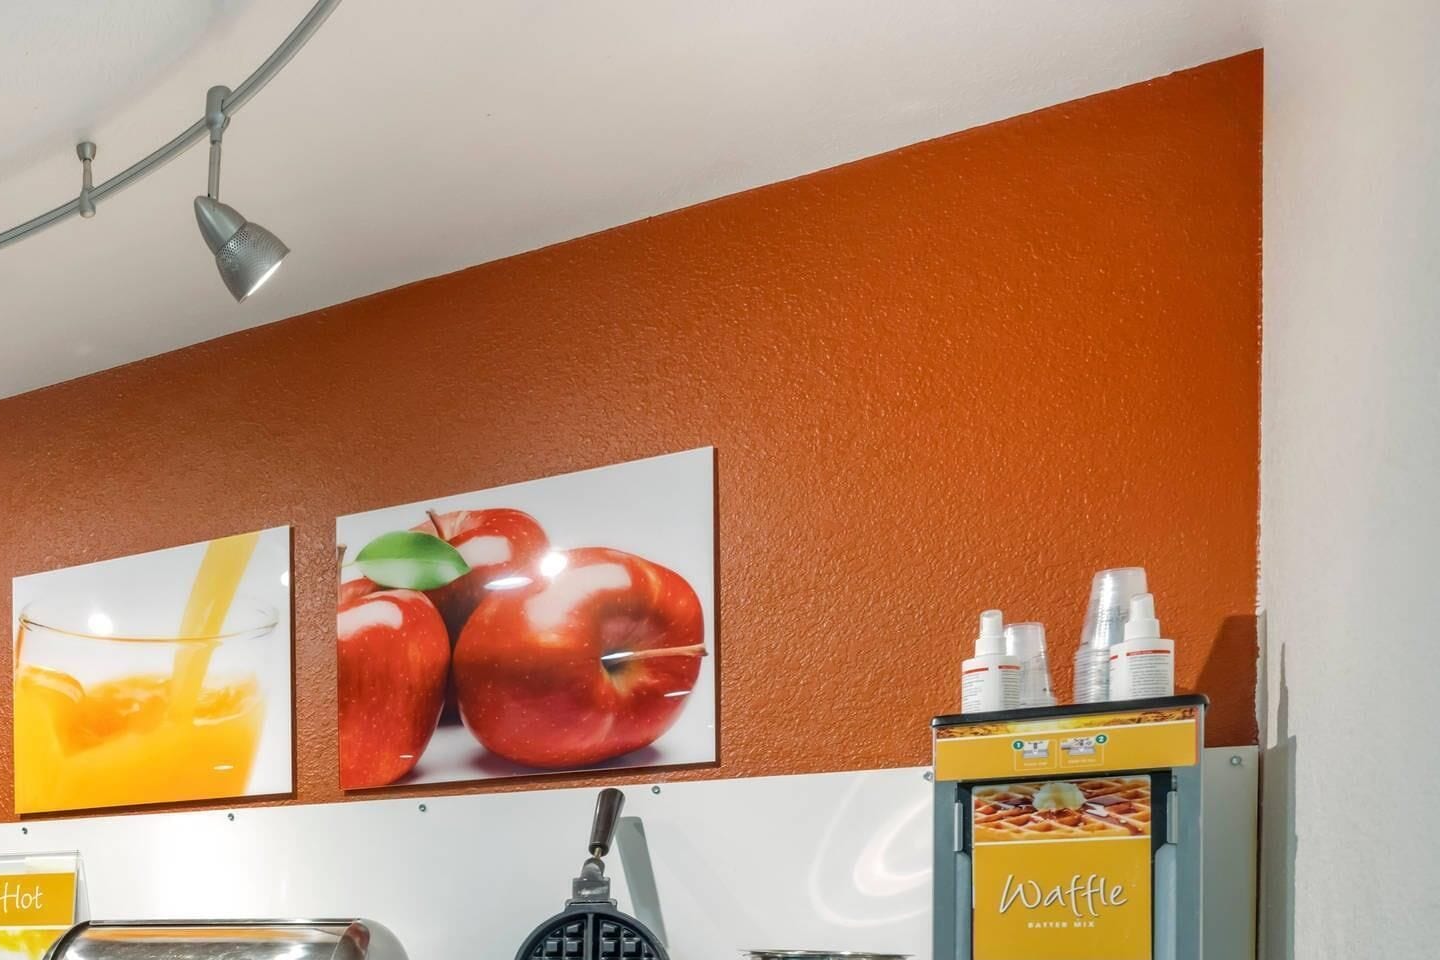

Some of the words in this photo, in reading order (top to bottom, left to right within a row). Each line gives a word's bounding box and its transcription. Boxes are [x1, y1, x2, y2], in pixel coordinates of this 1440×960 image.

[999, 874, 1128, 918] Waffle
[1027, 921, 1068, 929] BATTER
[1073, 920, 1096, 929] MIX
